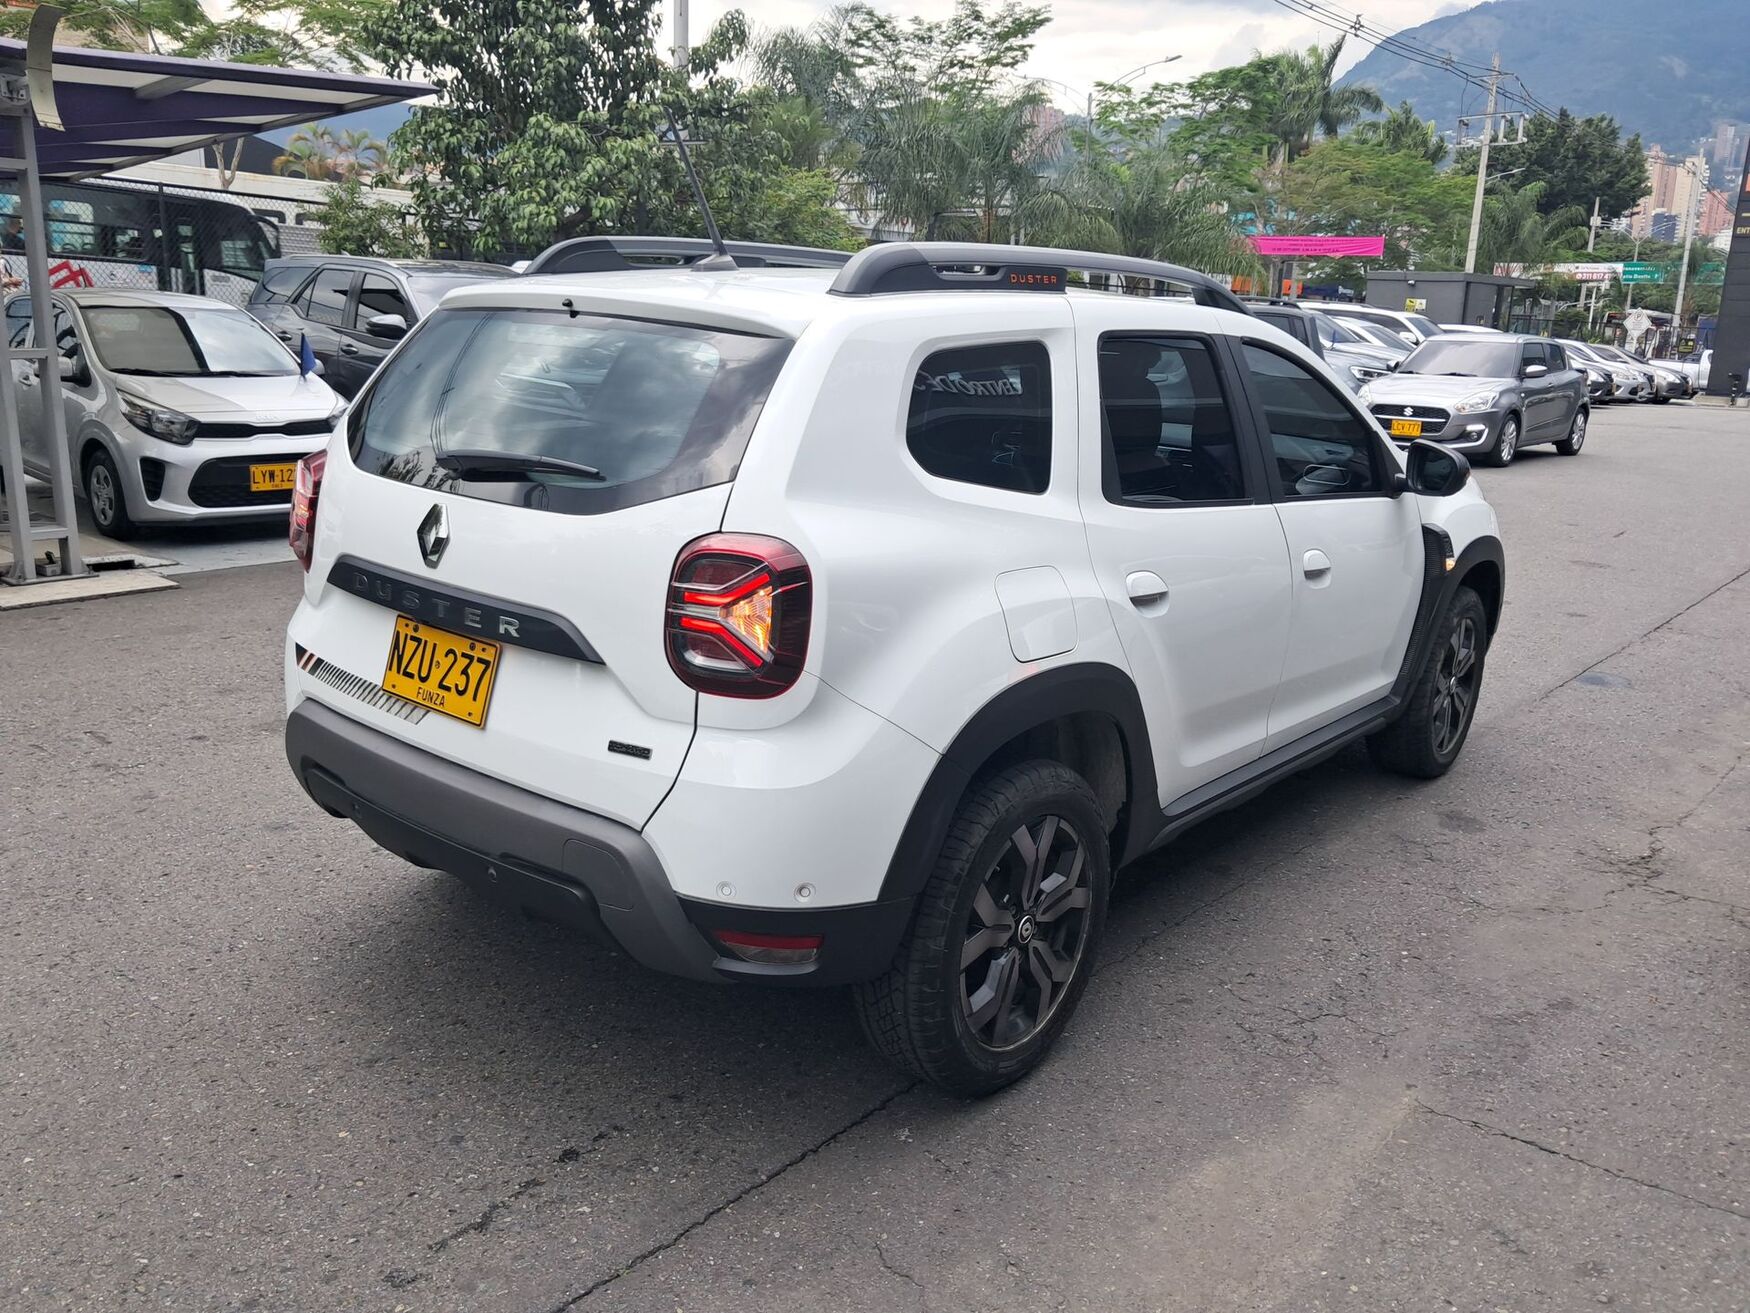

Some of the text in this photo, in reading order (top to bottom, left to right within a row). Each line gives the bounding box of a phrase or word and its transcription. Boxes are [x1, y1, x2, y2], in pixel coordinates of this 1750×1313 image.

[1009, 273, 1057, 284] DUSTER
[352, 572, 521, 638] DUSTER
[416, 686, 446, 708] FUNZA
